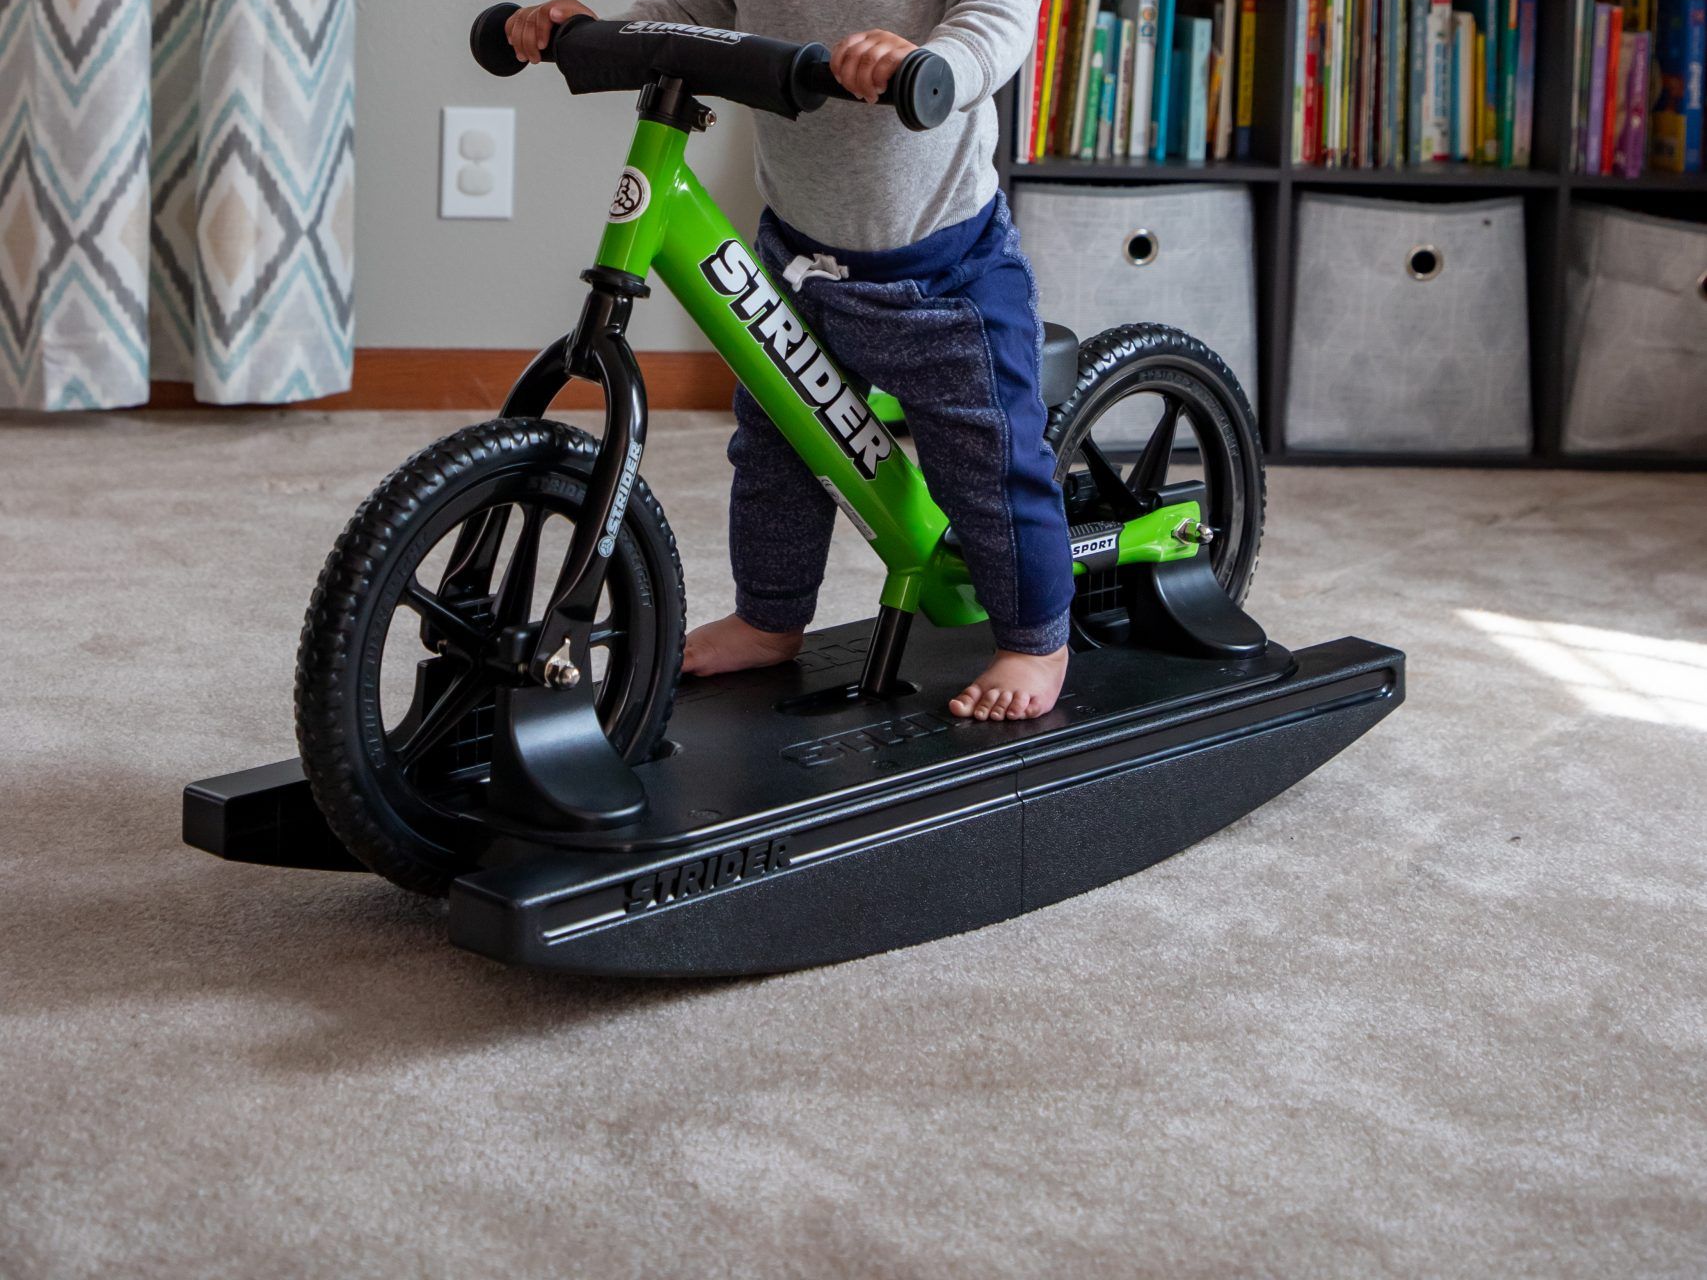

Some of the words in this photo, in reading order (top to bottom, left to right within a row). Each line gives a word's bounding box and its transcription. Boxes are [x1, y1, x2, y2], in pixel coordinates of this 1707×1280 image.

[699, 239, 893, 480] STRIDER
[606, 441, 643, 538] STRIDER
[1072, 538, 1114, 556] SPORT
[624, 834, 794, 914] STRIDER
